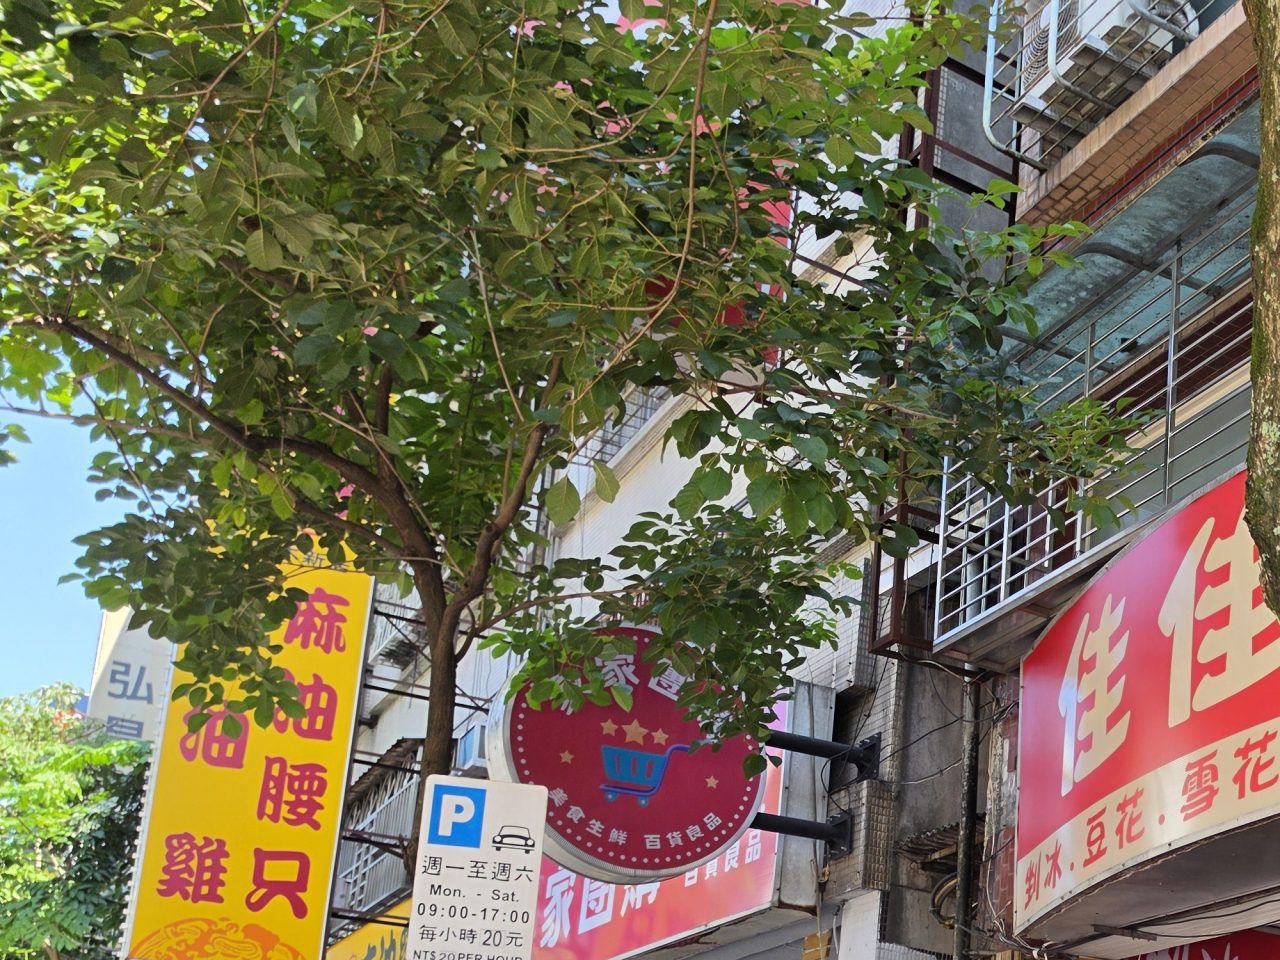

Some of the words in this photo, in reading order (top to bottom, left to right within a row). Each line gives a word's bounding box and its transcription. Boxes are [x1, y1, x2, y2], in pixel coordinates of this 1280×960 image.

[245, 586, 350, 920] 麻油腰只
[438, 793, 475, 837] P
[644, 811, 722, 852] 百貨良品
[421, 855, 534, 882] 週一至週六
[429, 884, 466, 899] Mon.
[491, 889, 519, 903] Sat.
[417, 902, 530, 924] 09:00-17:00
